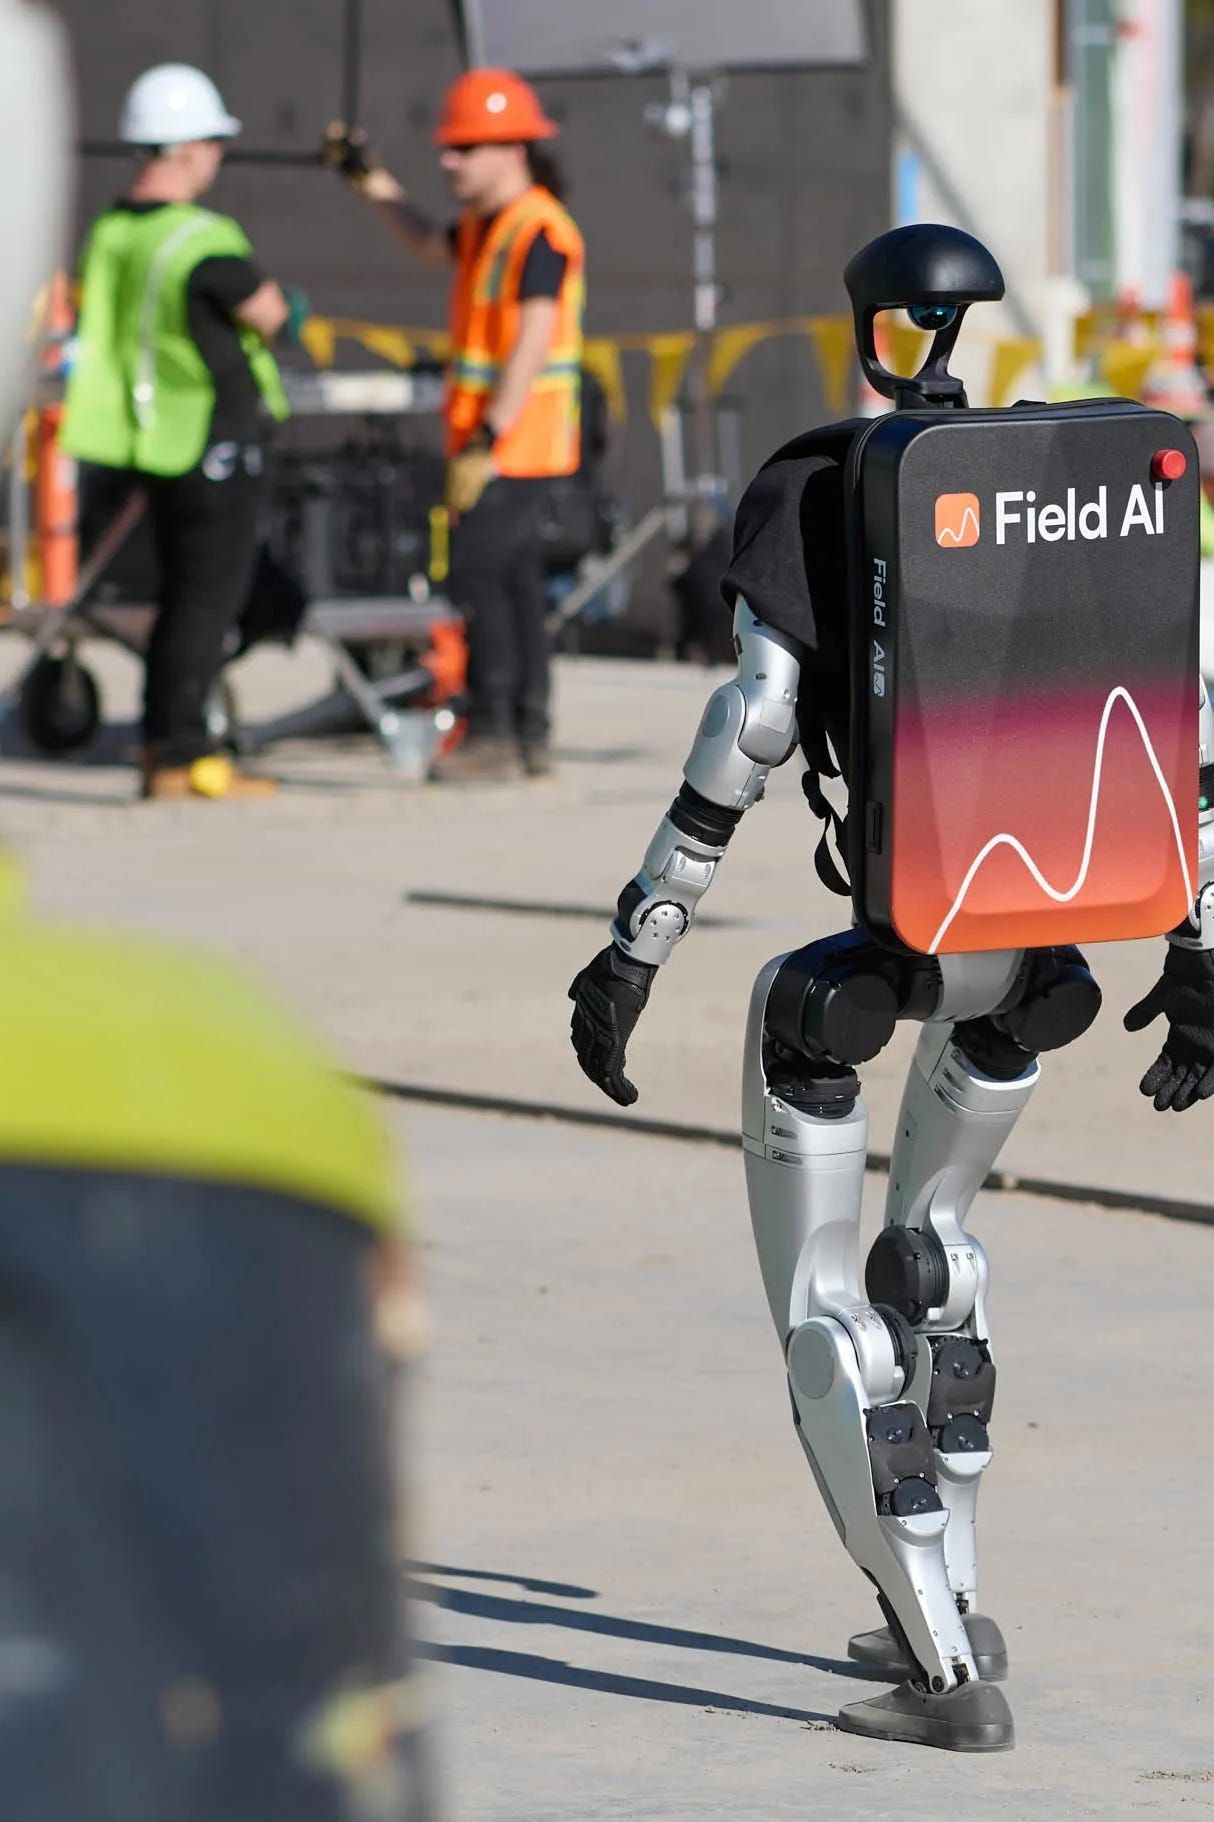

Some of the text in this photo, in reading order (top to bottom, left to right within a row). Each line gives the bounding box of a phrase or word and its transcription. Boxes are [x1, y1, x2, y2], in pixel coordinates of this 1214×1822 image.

[995, 482, 1164, 545] Field AI
[873, 558, 887, 673] Field AI
